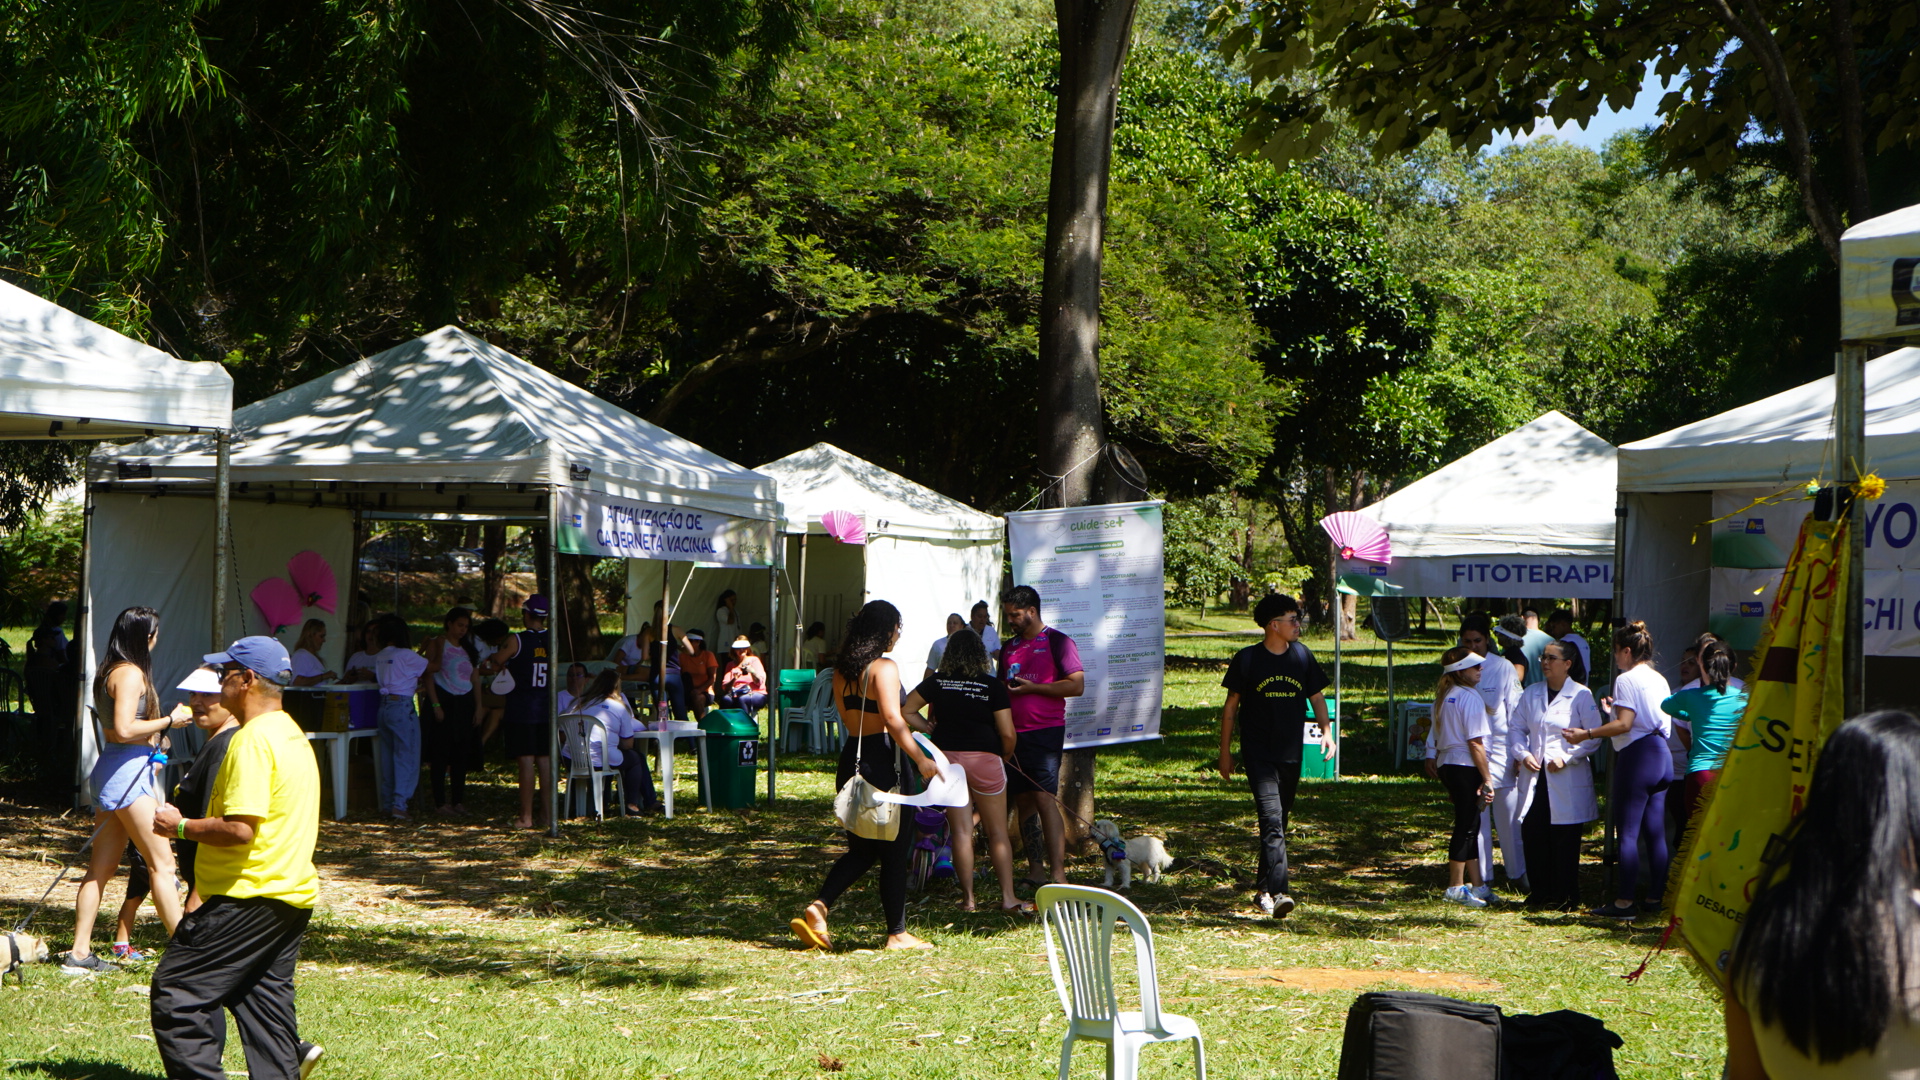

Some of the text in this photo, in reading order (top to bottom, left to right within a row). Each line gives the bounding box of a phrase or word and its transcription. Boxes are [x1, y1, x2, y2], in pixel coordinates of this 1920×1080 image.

[607, 505, 703, 532] ATUALIZAÇÃO DE
[1070, 516, 1125, 532] cuide-se+
[596, 528, 717, 554] CADERNETA VACINAL
[532, 663, 548, 687] 15
[1256, 676, 1274, 692] GRUPO
[1285, 676, 1302, 691] TEATRO
[1696, 894, 1745, 924] DESACE
